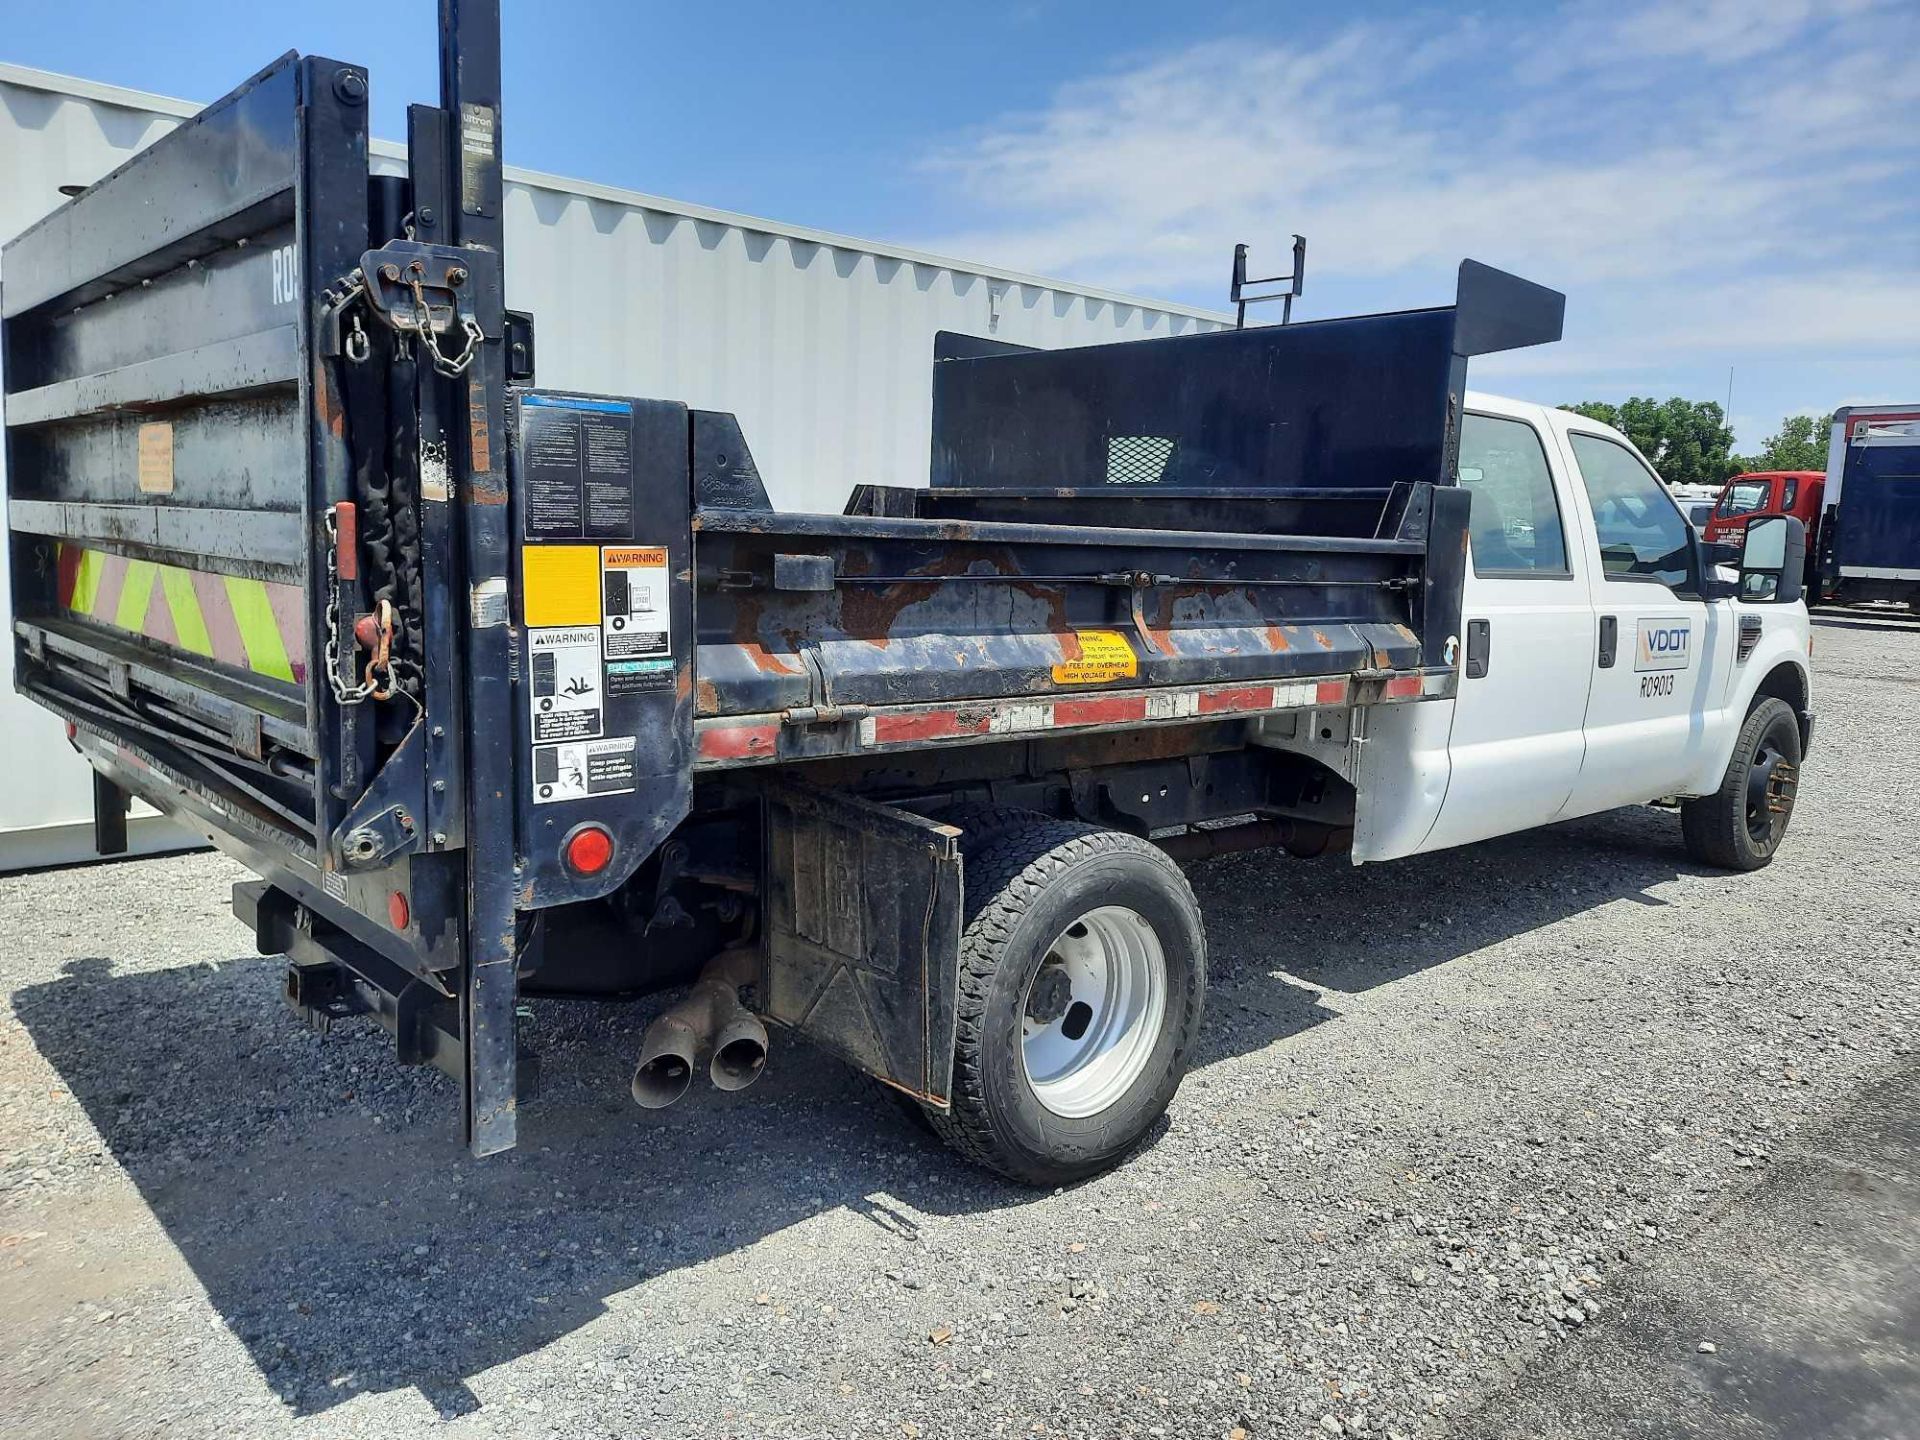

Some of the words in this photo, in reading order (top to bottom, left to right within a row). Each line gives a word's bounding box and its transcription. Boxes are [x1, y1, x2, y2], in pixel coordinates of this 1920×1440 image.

[616, 553, 663, 563] WARNING
[545, 632, 595, 644] WARNING
[1647, 629, 1689, 652] VDOT
[1097, 661, 1129, 669] OVERHEAD
[1080, 671, 1107, 679] VOLTAGE
[1640, 674, 1674, 698] R09013
[595, 742, 634, 752] WARNING
[590, 759, 605, 767] Keep
[606, 757, 626, 765] people
[590, 766, 605, 774] clear
[590, 773, 606, 781] while
